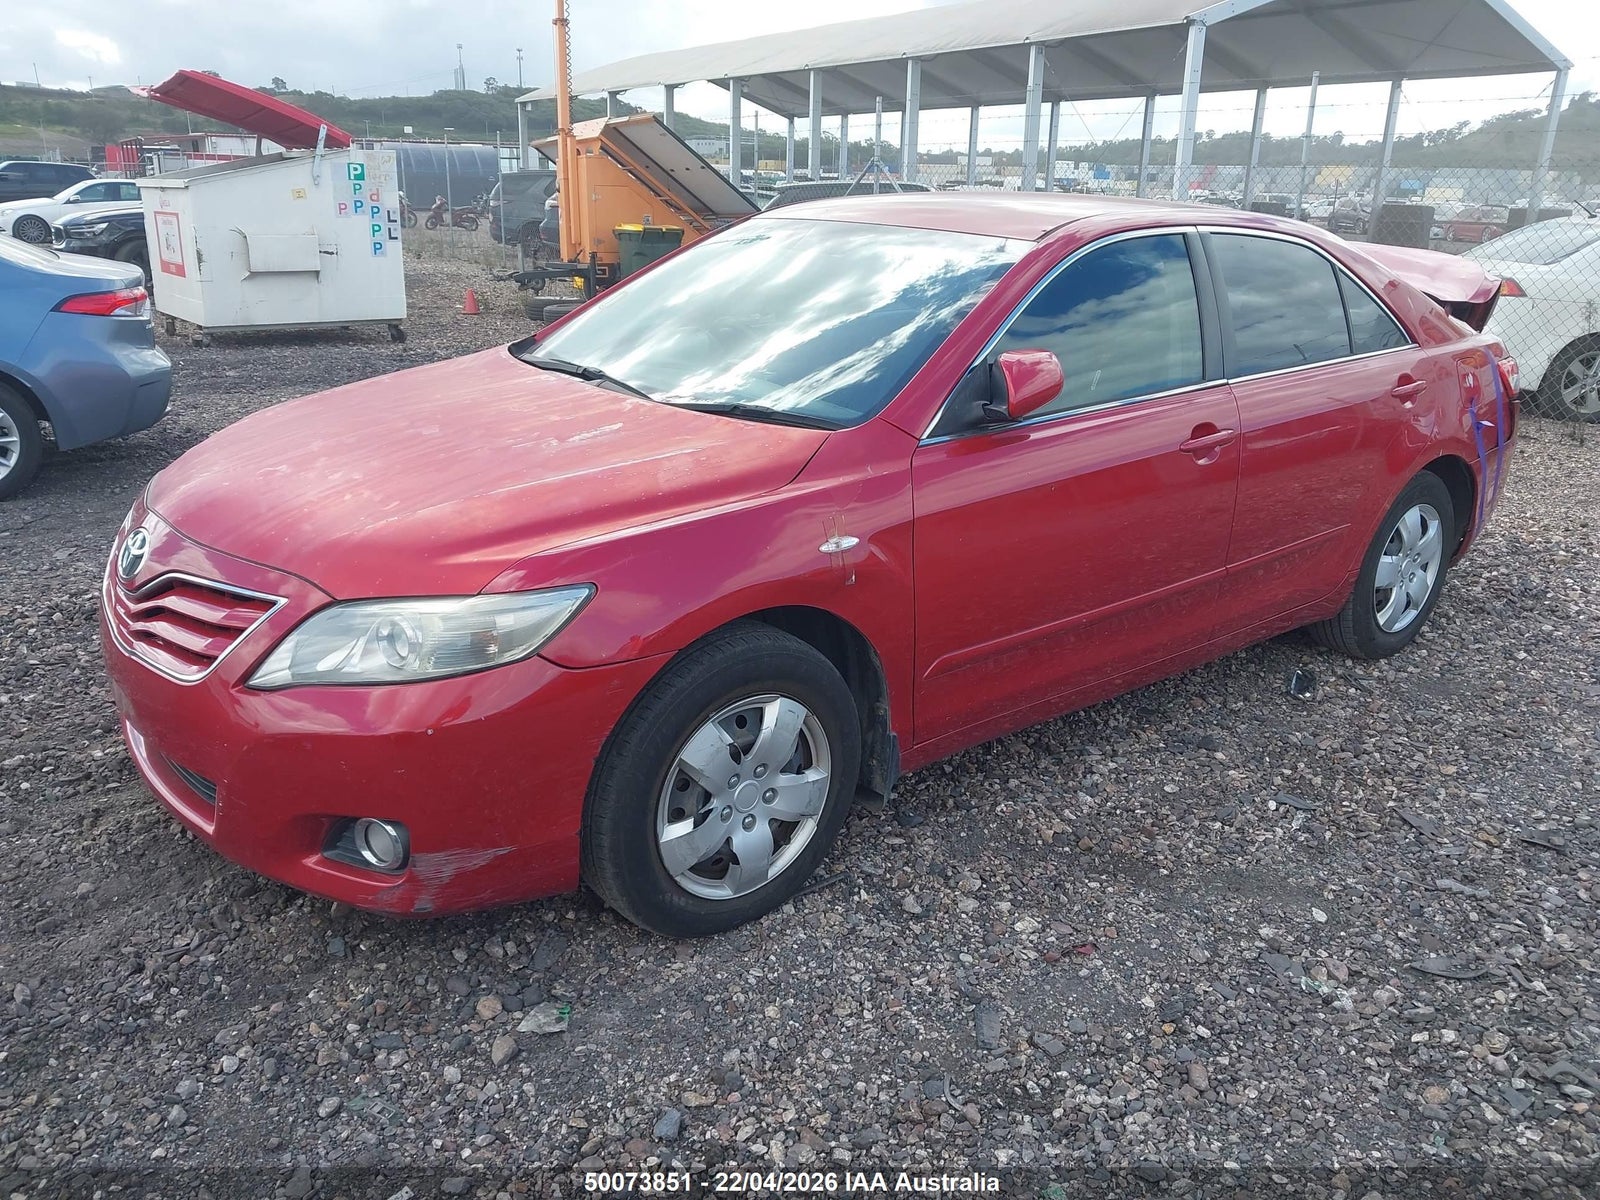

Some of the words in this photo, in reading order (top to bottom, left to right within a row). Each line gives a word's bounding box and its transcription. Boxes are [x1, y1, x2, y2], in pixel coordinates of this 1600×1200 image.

[349, 164, 362, 180] P
[353, 183, 362, 195] P
[338, 202, 348, 215] P
[354, 200, 364, 214] P
[371, 206, 380, 219] P
[387, 210, 397, 223] L
[372, 224, 382, 238] P
[388, 227, 398, 240] L
[373, 242, 383, 255] P
